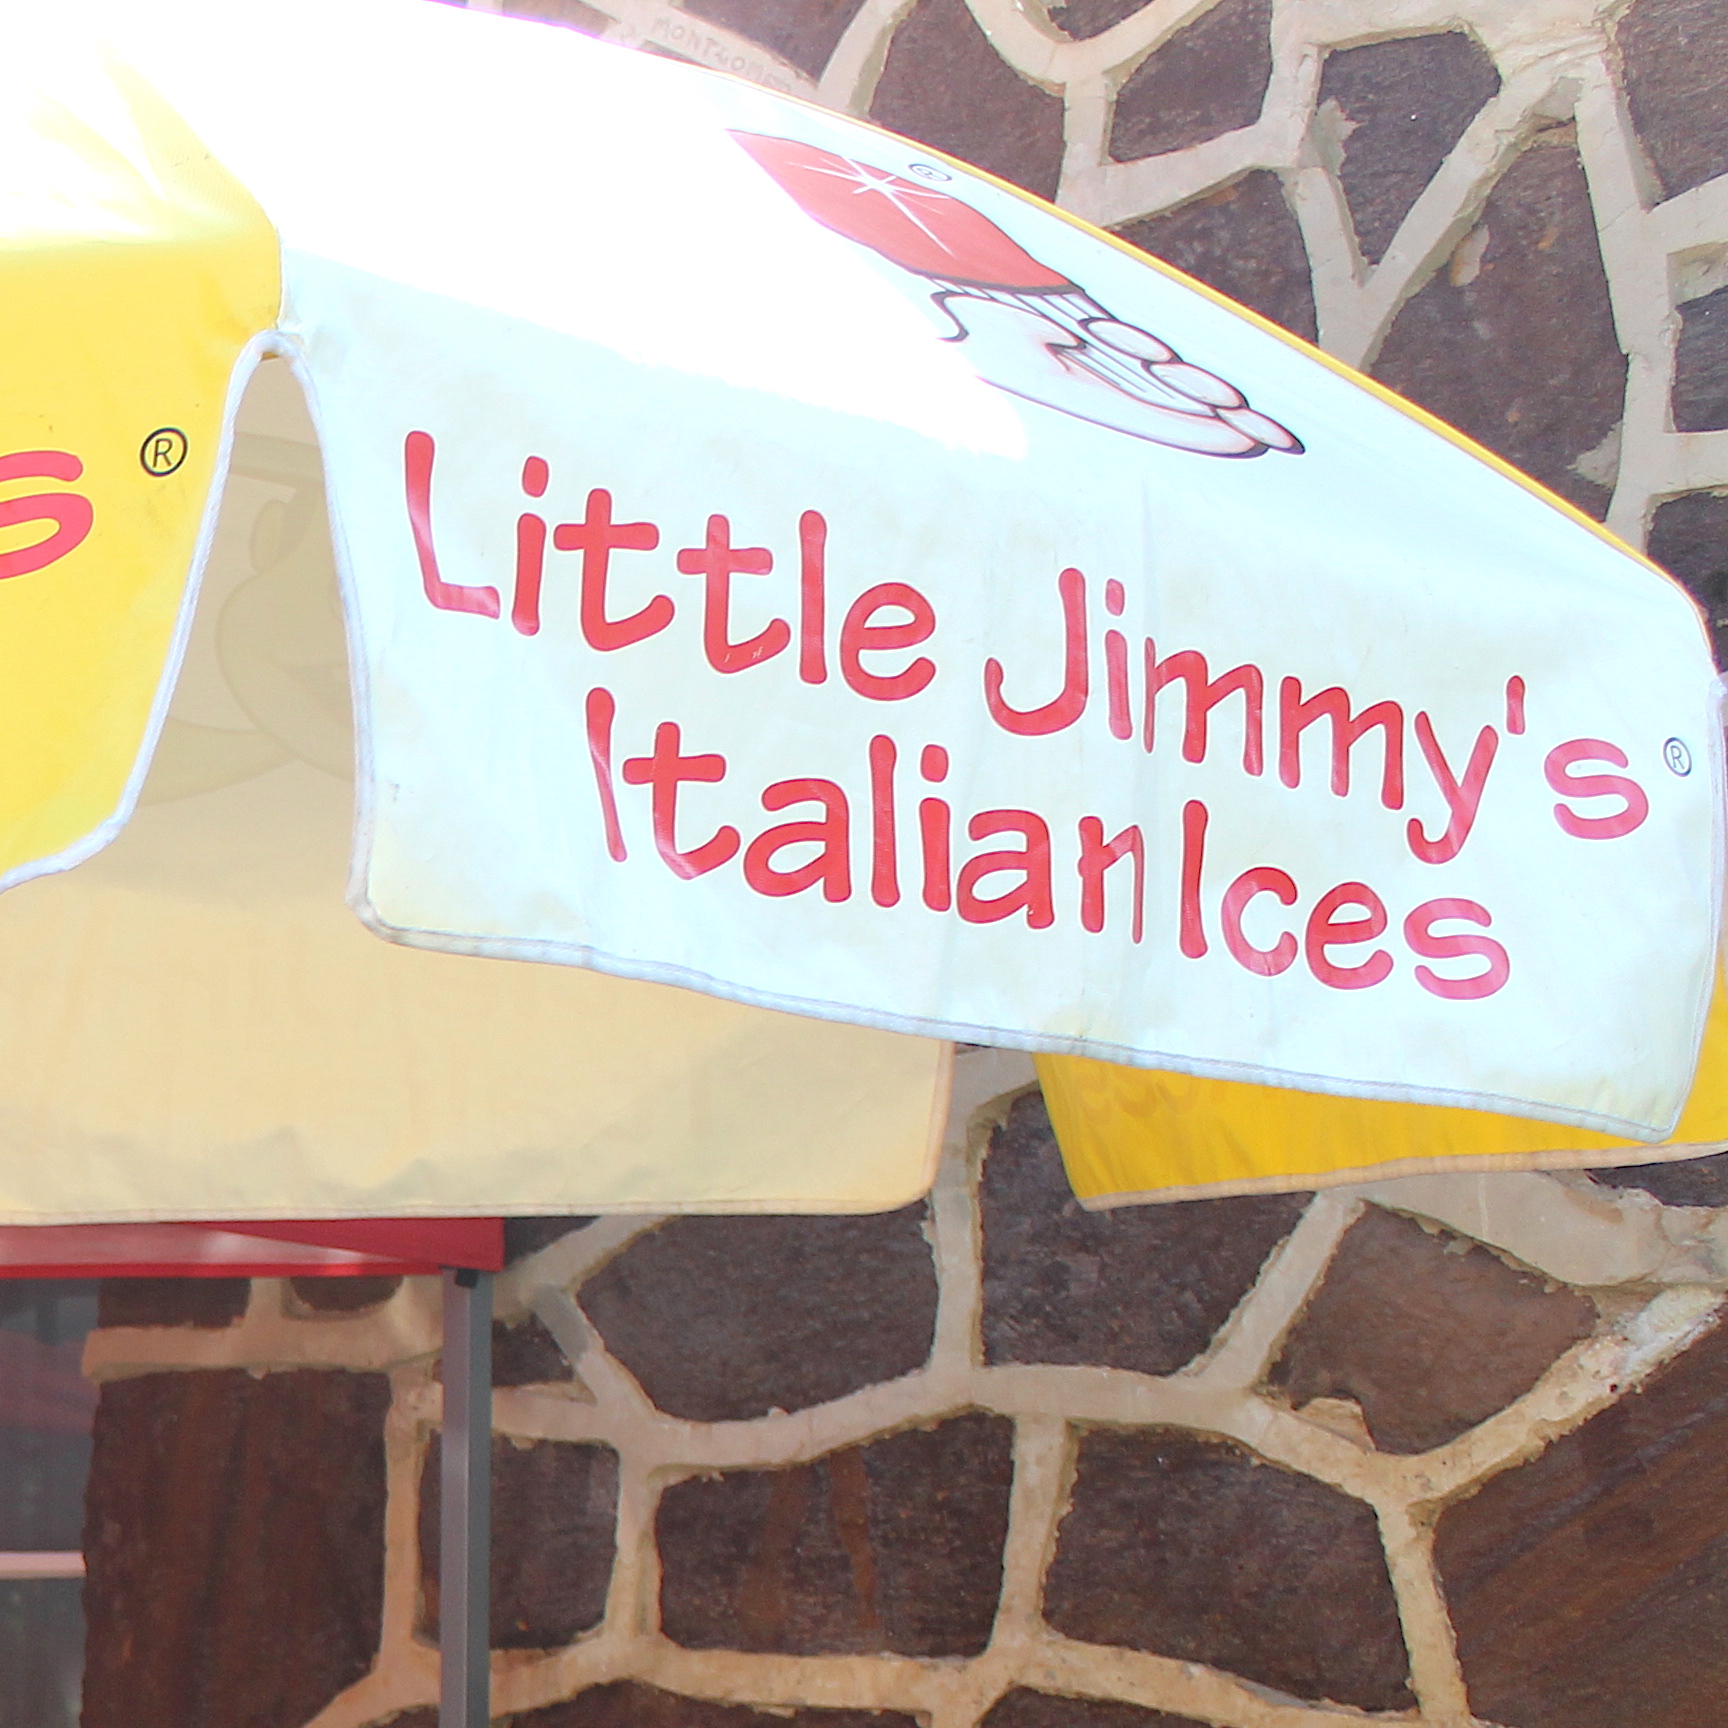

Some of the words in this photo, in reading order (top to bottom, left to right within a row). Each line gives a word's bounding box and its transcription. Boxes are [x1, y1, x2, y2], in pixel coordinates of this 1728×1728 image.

[405, 431, 937, 702] Little
[984, 567, 1650, 864] Jimmy's
[584, 687, 1145, 945] Italian
[1178, 799, 1511, 1001] Ices
